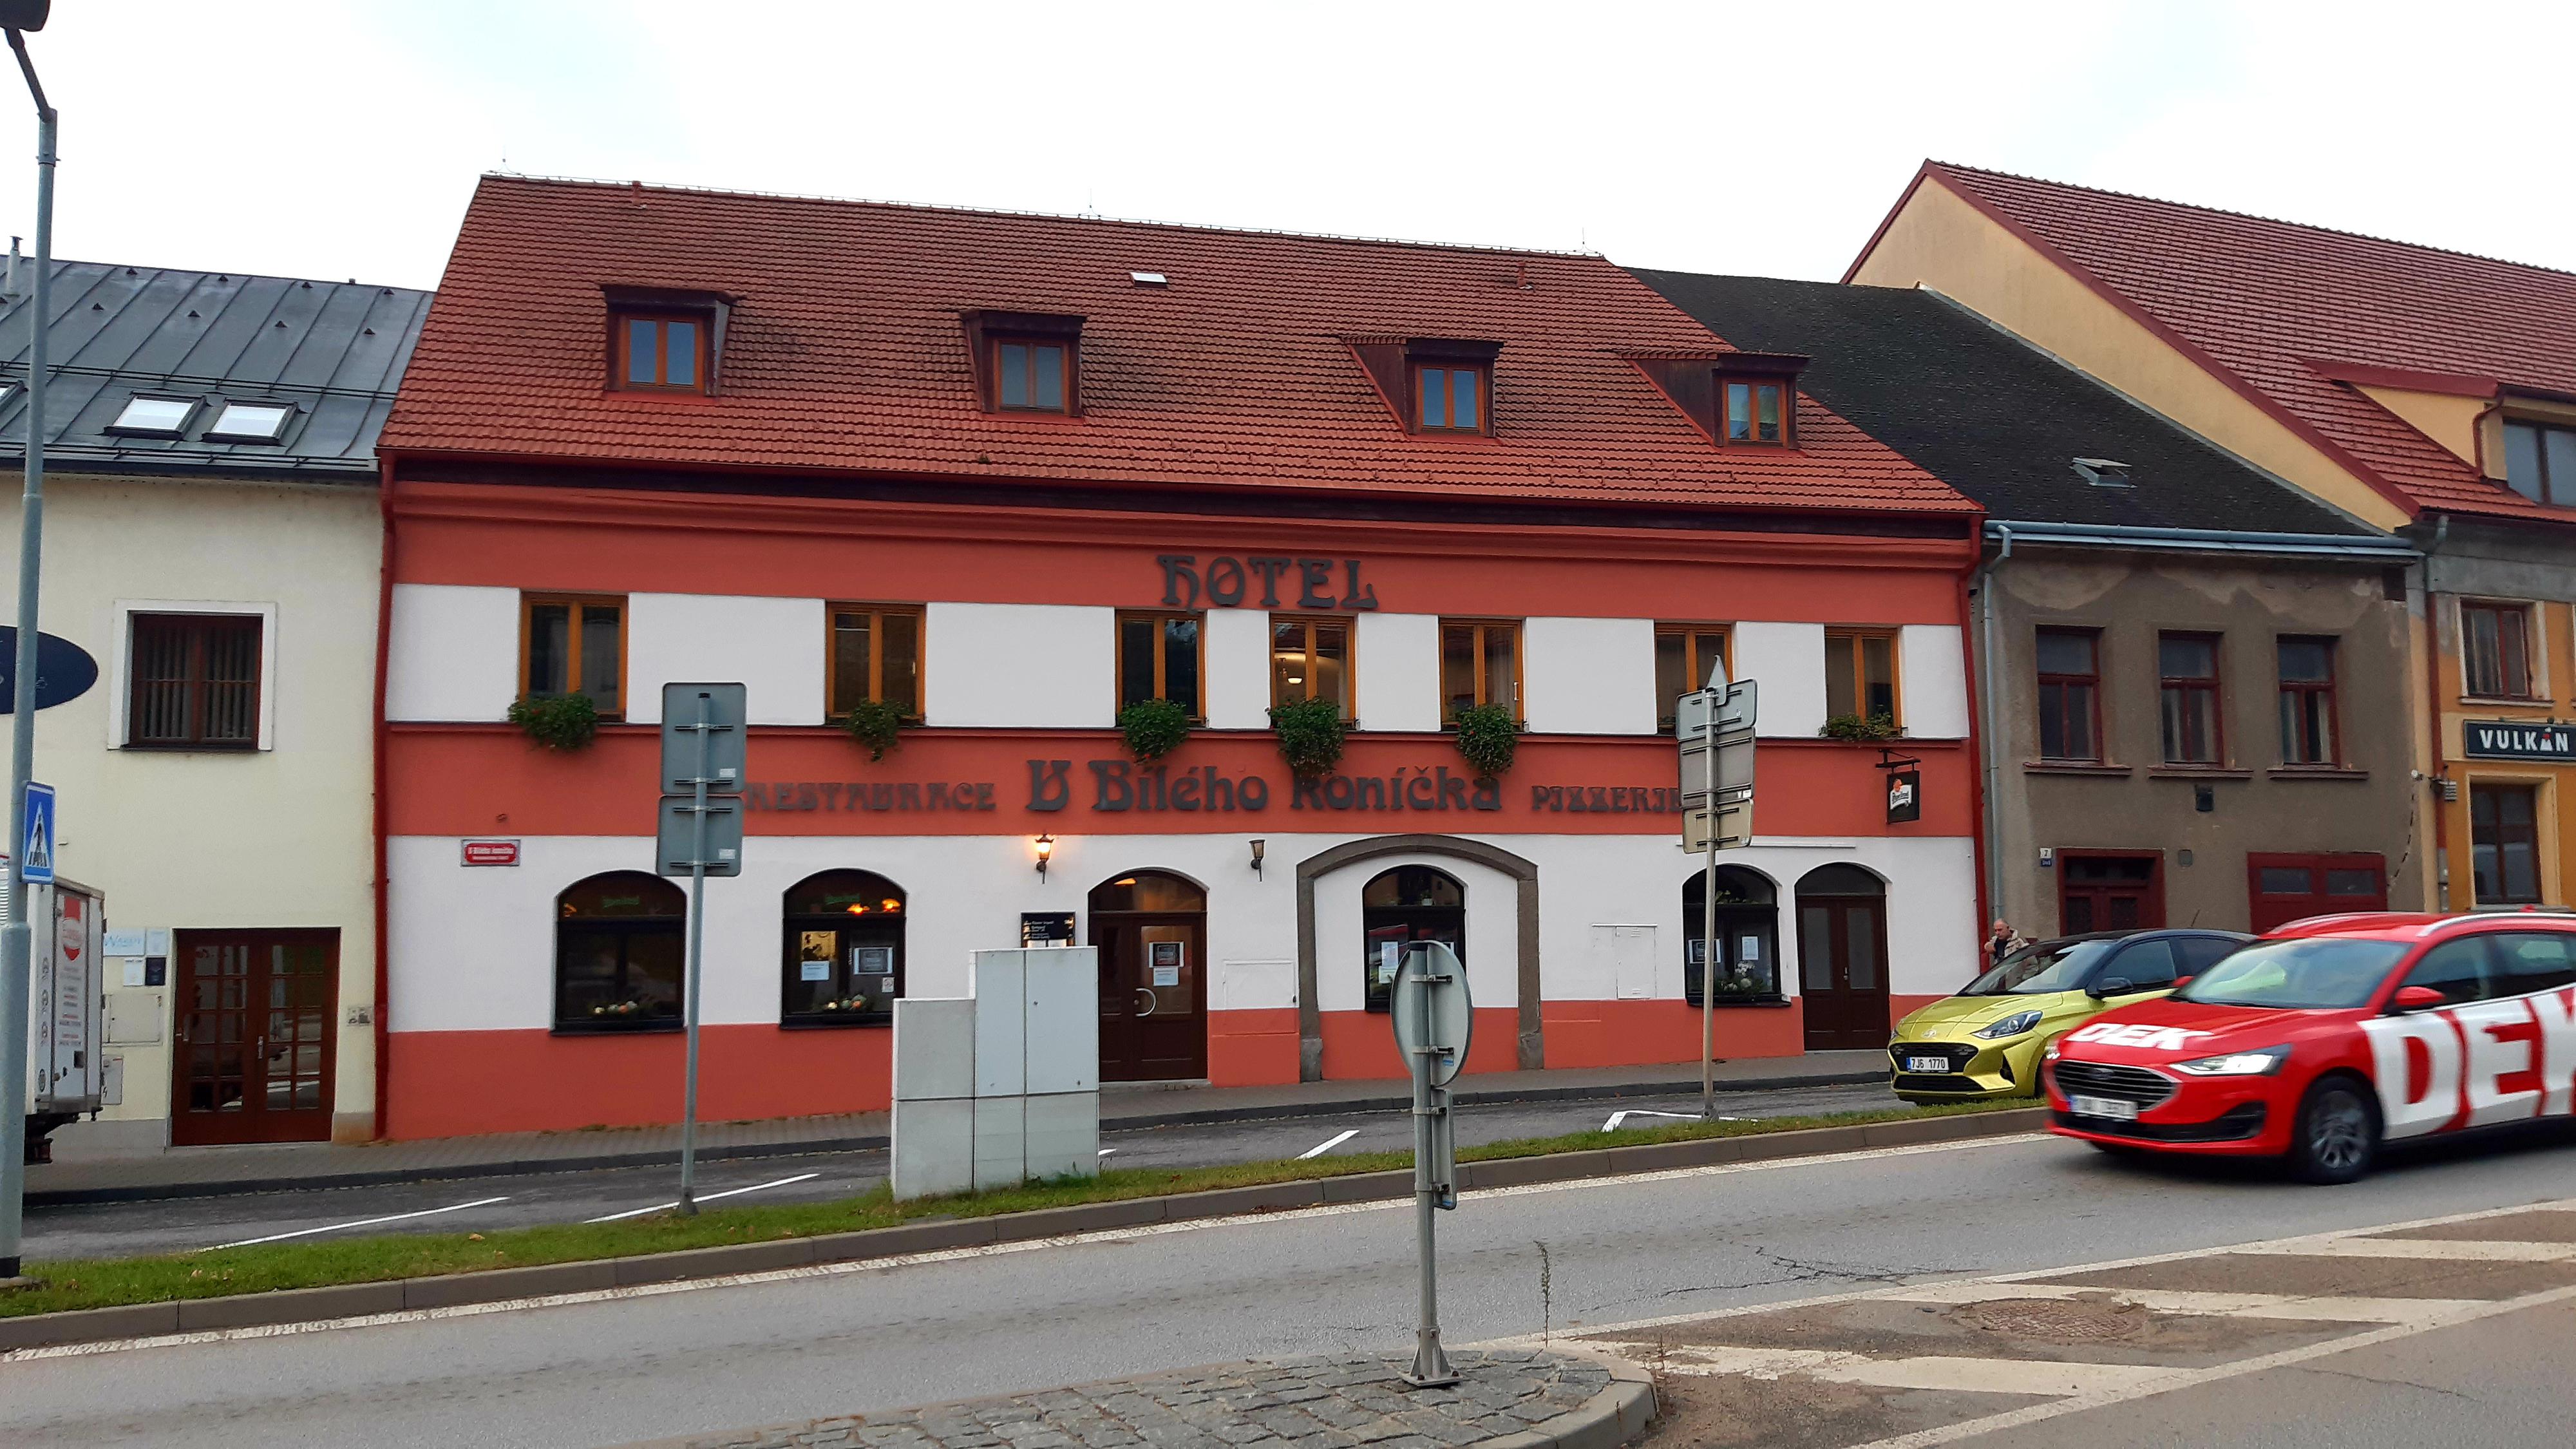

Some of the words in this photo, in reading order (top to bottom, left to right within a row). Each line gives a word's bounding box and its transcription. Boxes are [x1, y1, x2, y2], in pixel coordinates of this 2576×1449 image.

[1157, 555, 1378, 614] HOTEL
[746, 782, 996, 811] RESTAURACE
[1088, 760, 1269, 811] Bílého
[2064, 1023, 2214, 1050] DEK
[1911, 1058, 1924, 1068] 7J6
[1929, 1059, 1945, 1069] 1770
